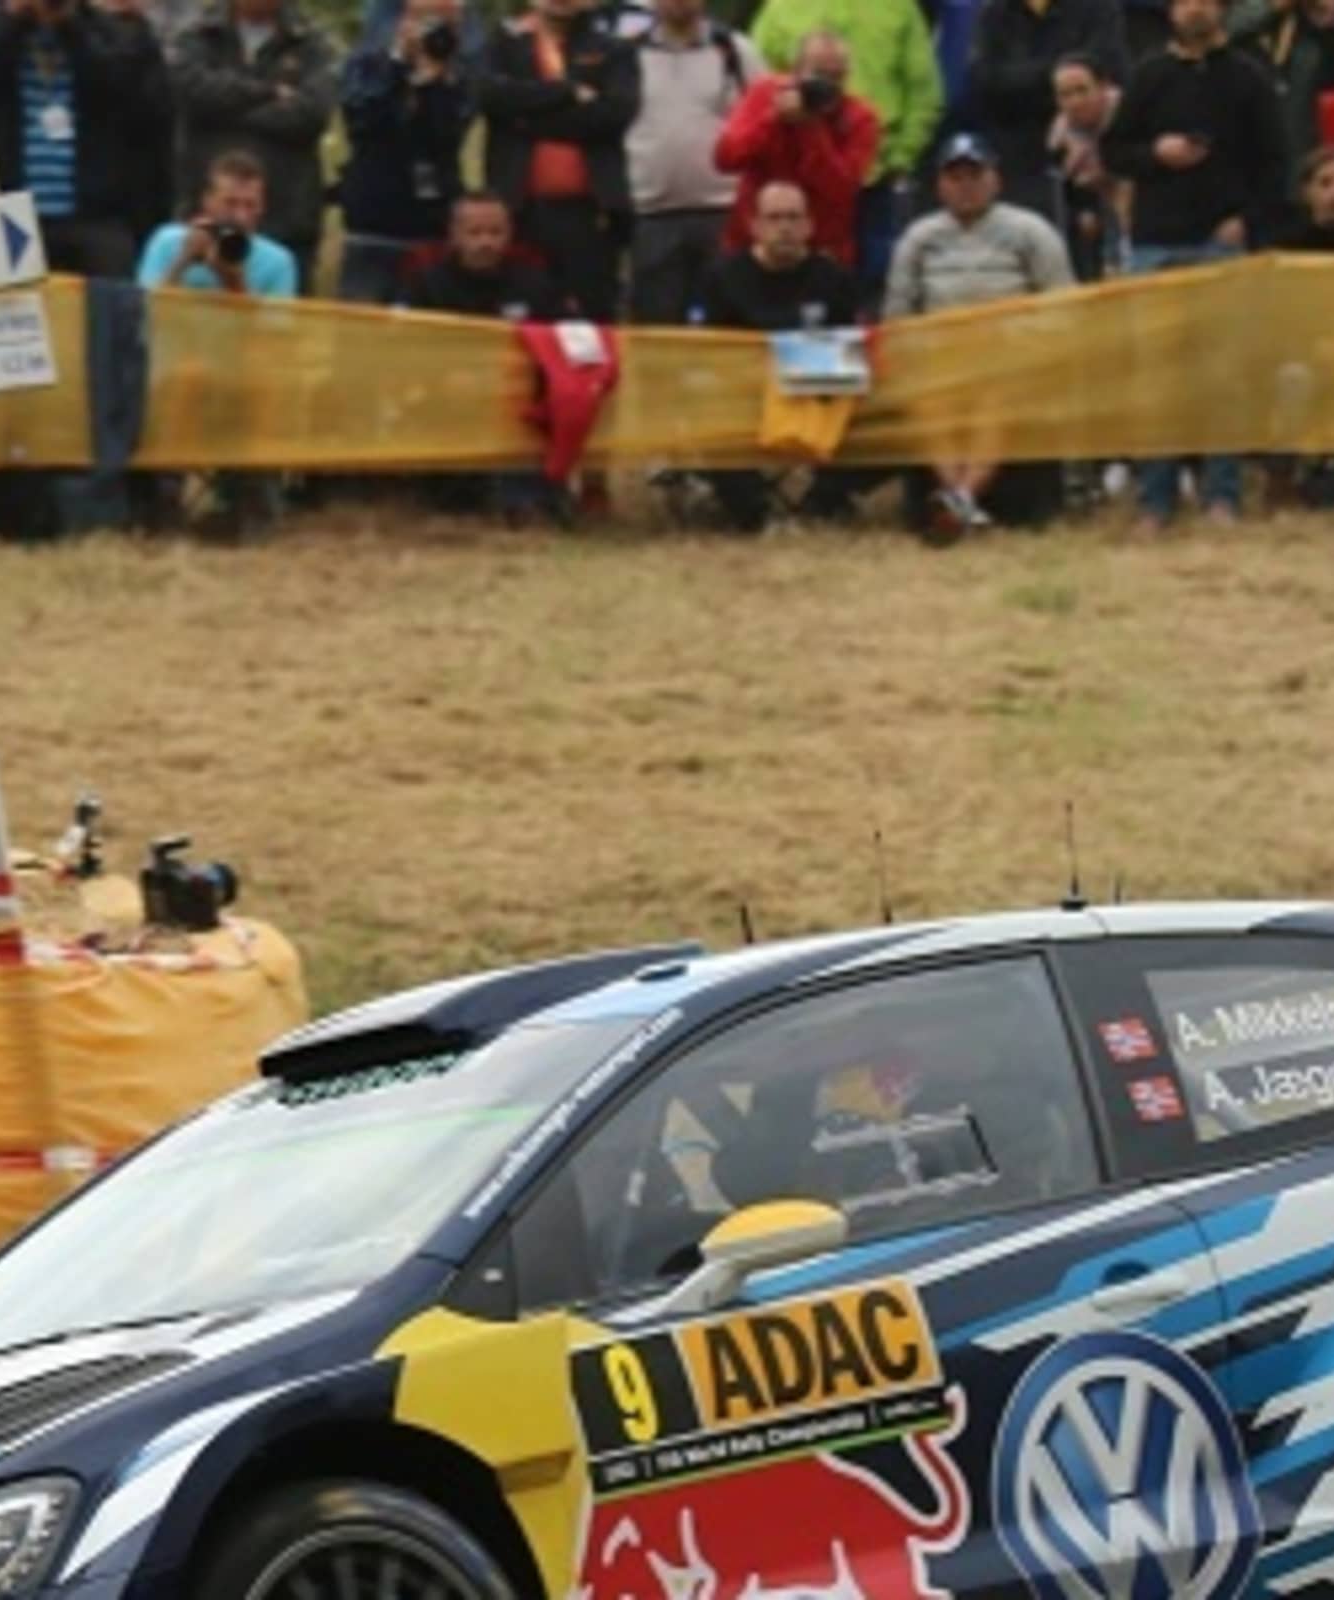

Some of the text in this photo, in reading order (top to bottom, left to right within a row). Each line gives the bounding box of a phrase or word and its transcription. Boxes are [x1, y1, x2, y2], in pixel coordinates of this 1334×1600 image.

[1176, 1012, 1216, 1051] A.
[1204, 1070, 1244, 1110] A.
[703, 1289, 921, 1420] ADAC
[602, 1342, 659, 1444] 9
